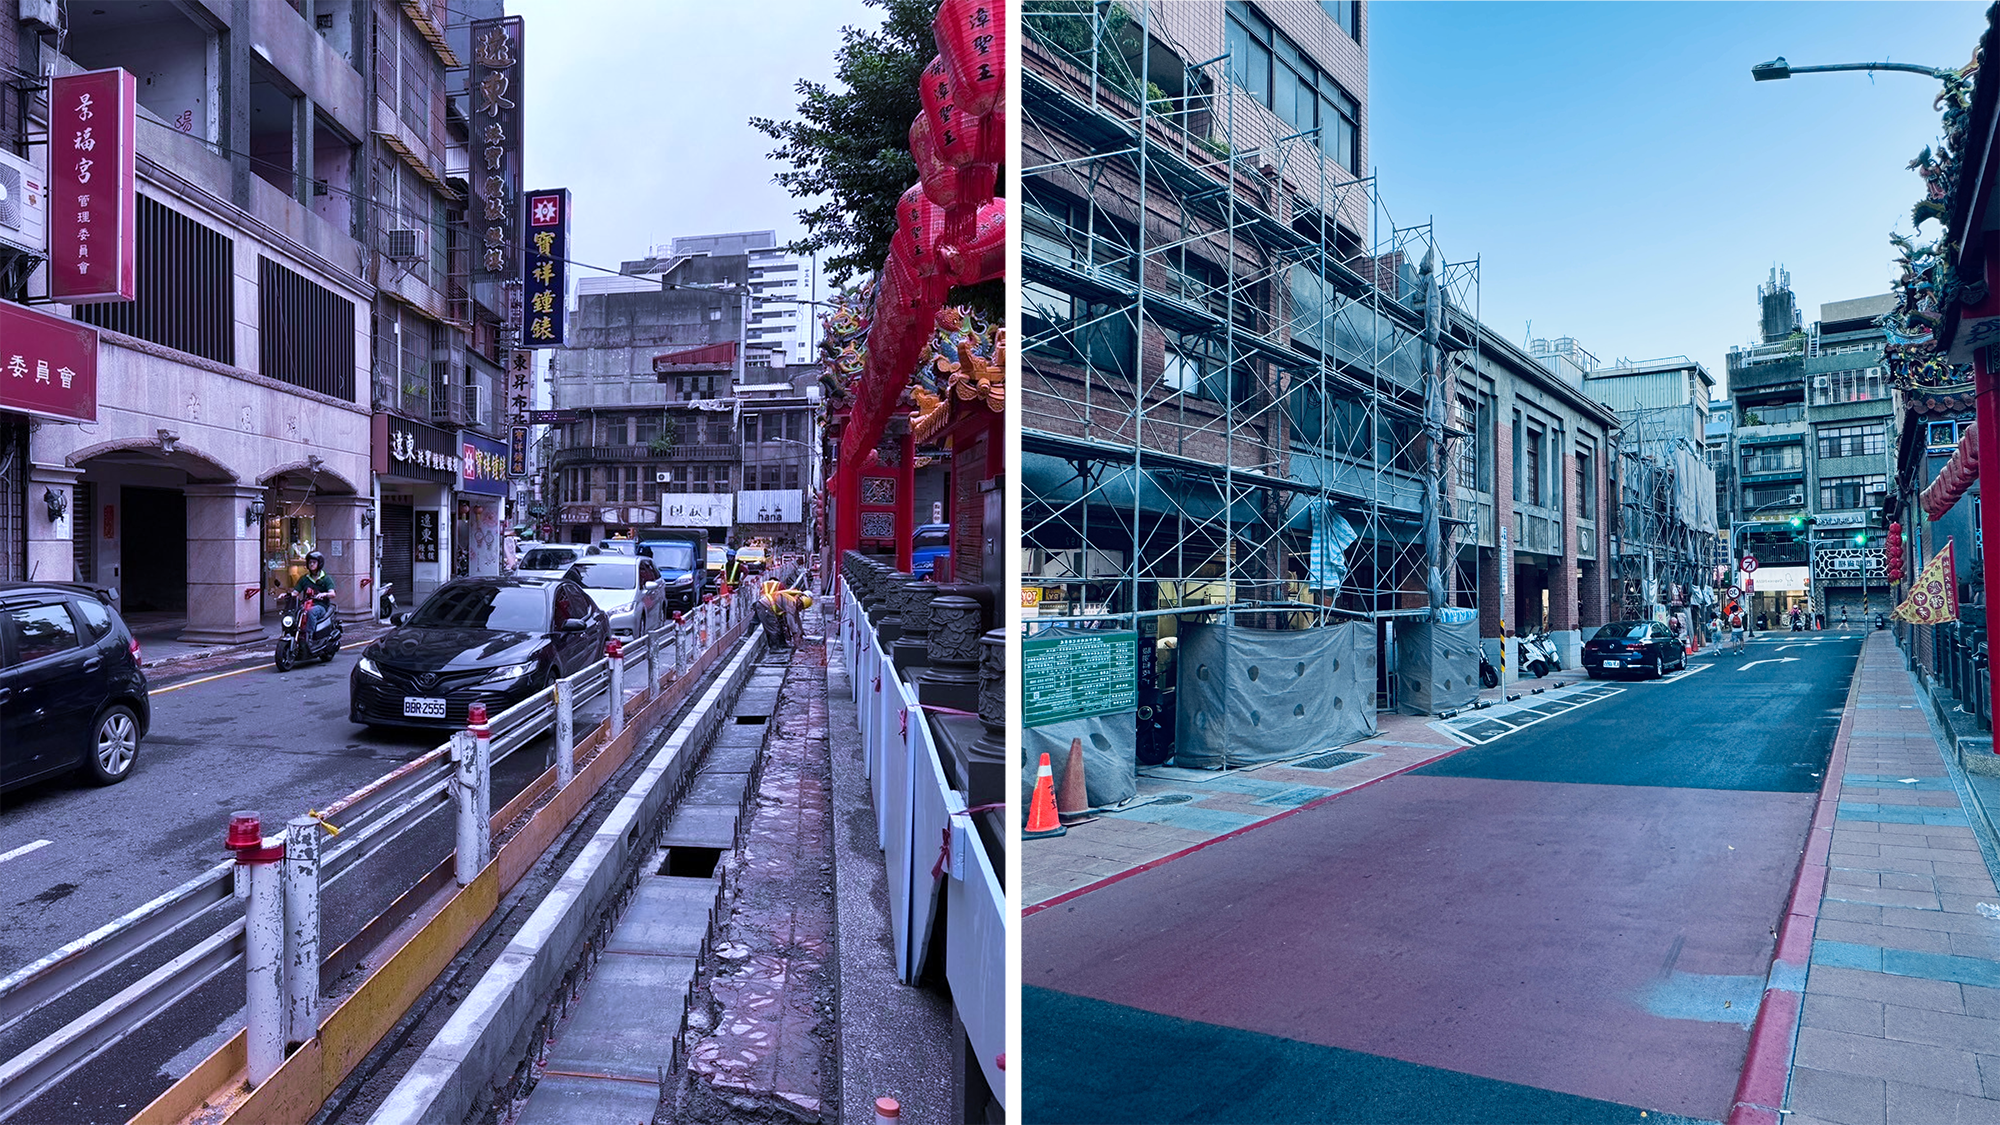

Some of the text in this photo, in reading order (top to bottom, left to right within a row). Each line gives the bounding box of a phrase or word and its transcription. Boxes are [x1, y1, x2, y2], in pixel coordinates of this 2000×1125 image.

[74, 93, 96, 275] 景福宮管理委員會
[530, 230, 556, 340] 寶祥鐘錶
[0, 354, 76, 389] 委員會
[420, 513, 433, 542] 遠東
[757, 511, 783, 522] hana
[405, 701, 445, 715] BBR-2555
